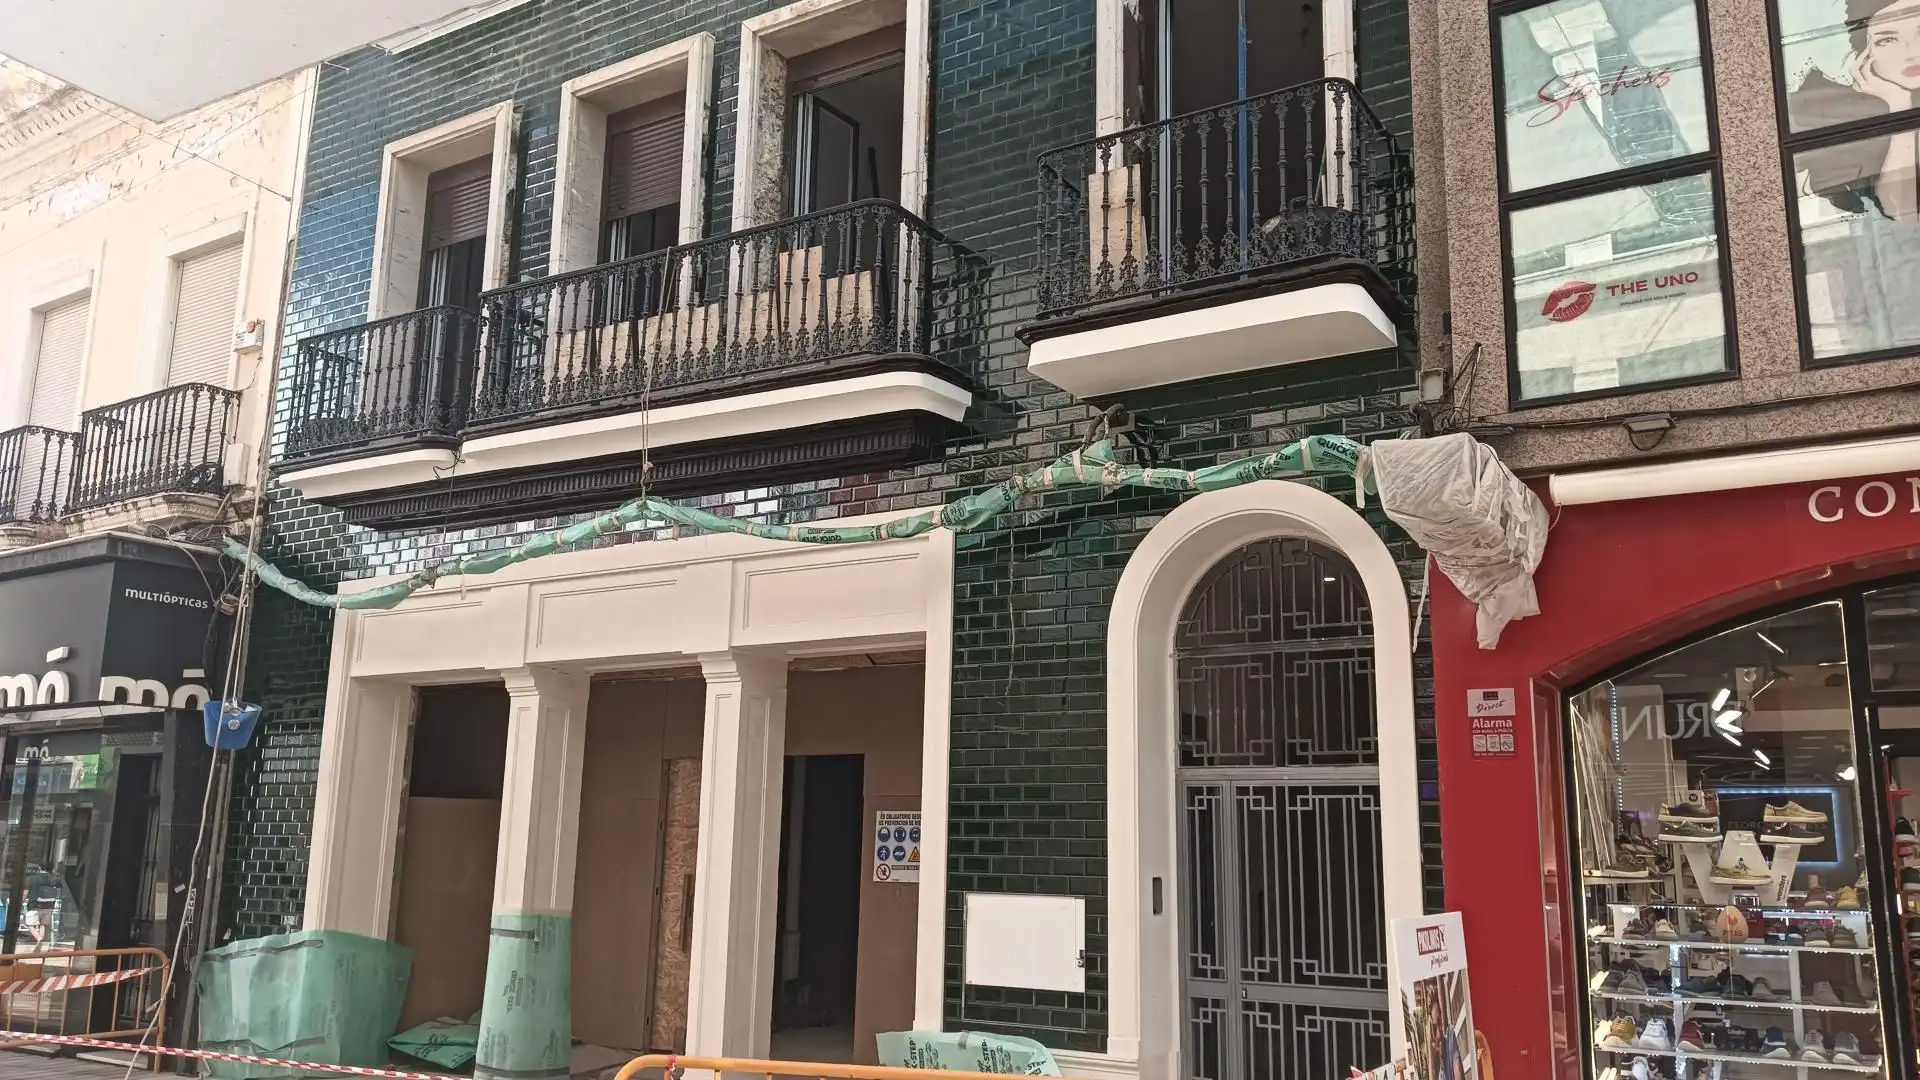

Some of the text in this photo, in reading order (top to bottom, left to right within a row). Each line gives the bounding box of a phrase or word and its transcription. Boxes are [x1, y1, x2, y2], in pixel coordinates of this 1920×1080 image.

[1606, 271, 1699, 297] THE UNO
[1472, 718, 1513, 729] Alarma
